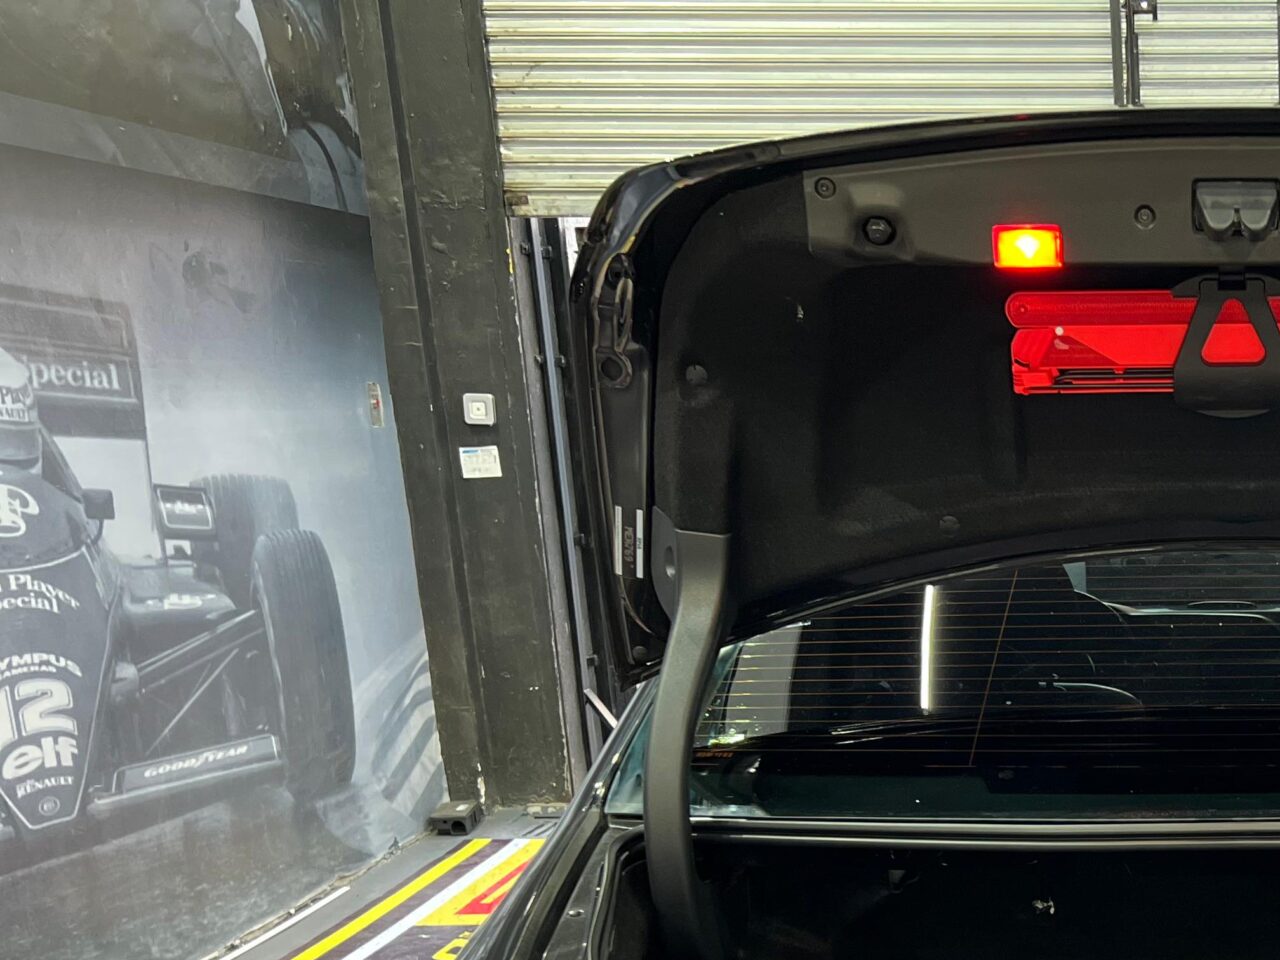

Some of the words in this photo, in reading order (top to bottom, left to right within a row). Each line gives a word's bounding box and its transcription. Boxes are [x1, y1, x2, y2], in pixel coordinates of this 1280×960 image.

[30, 360, 121, 390] pecial
[0, 592, 60, 613] ecial
[2, 736, 78, 780] elf
